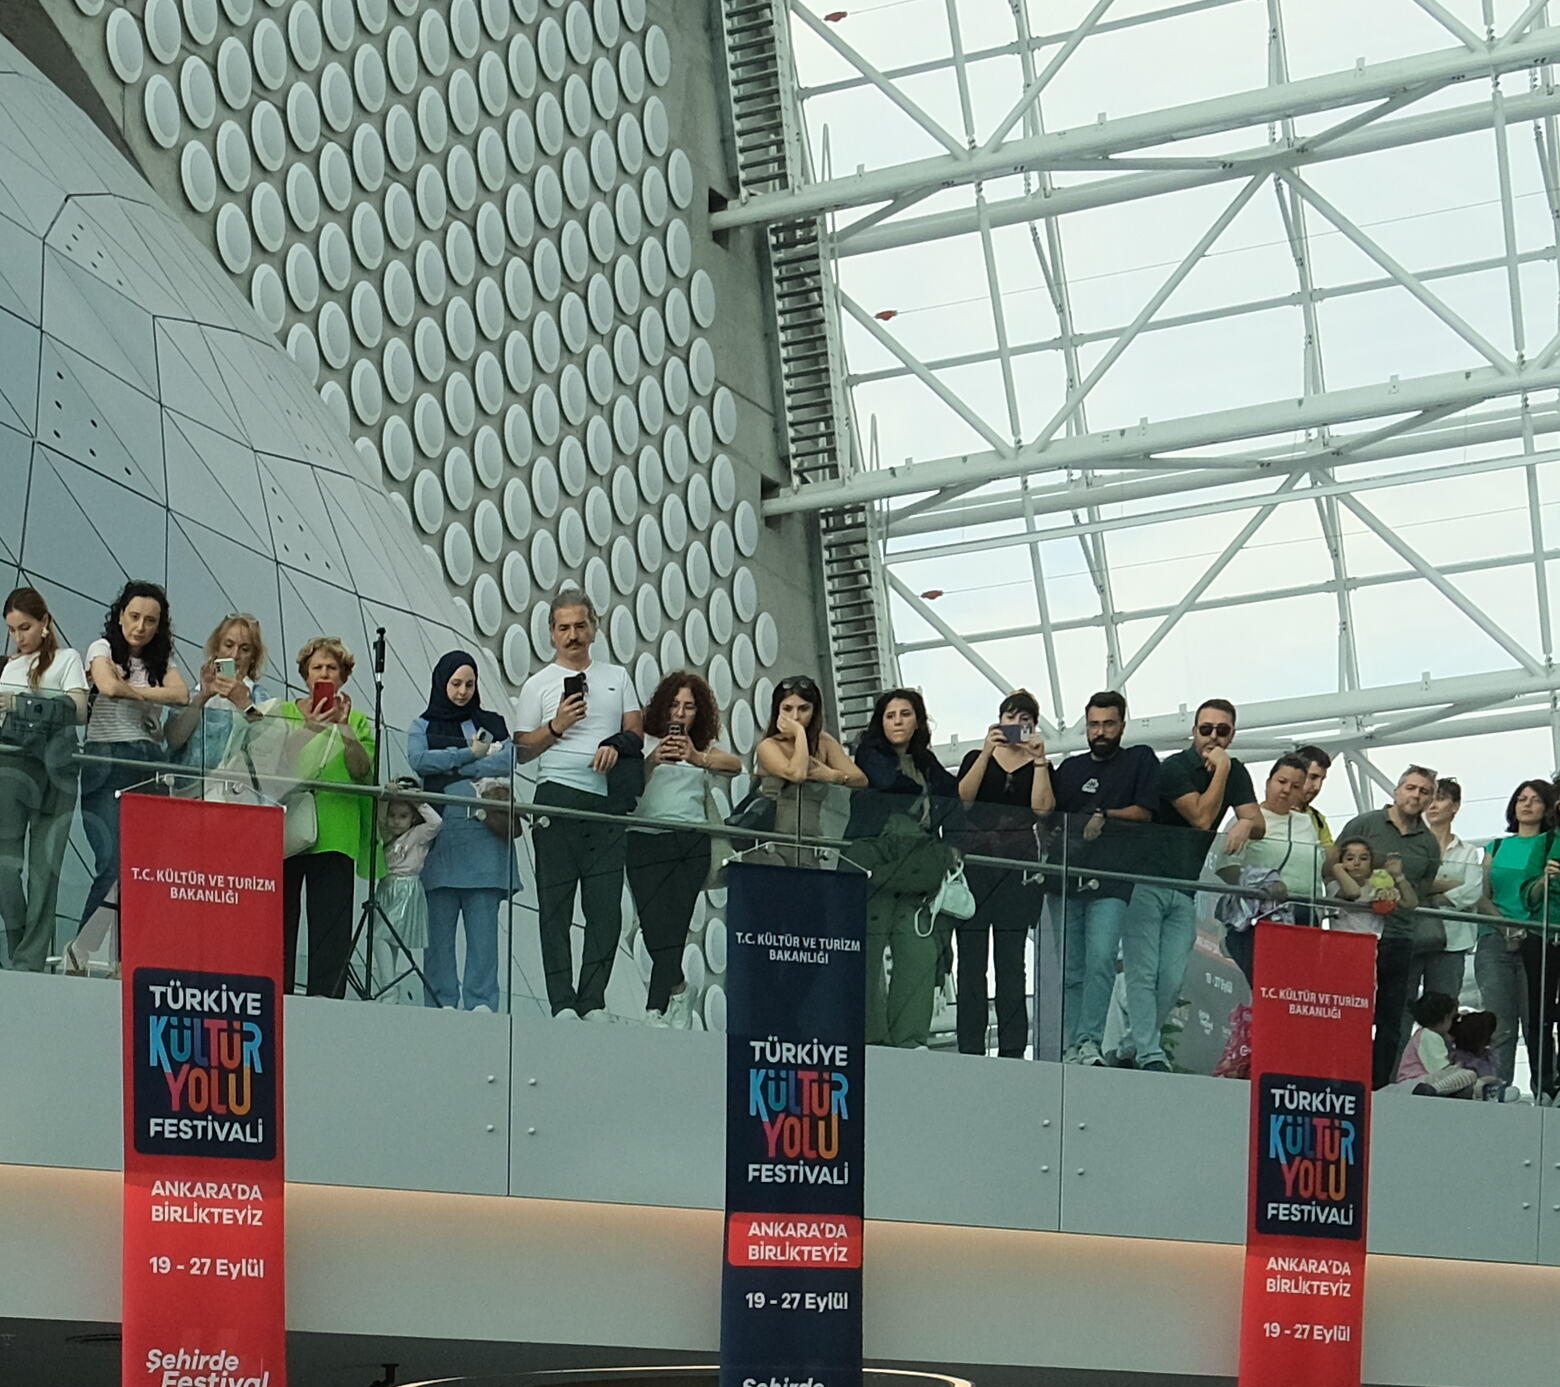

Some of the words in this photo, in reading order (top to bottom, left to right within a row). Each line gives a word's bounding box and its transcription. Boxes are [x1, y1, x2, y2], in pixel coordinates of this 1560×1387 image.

[131, 868, 154, 881] T.C.
[157, 868, 205, 886] KÜLTÜR
[209, 875, 224, 888] VE
[228, 877, 276, 892] TURİZM
[170, 887, 238, 905] BAKANLIĞI
[736, 932, 756, 945] T.C.
[758, 932, 800, 947] KÜLTÜR
[803, 937, 816, 949] VE
[819, 937, 861, 951] TURİZM
[769, 948, 829, 965] BAKANLIĞI
[149, 980, 261, 1016] TÜRKİYE
[1261, 987, 1278, 999] T.C.
[1280, 988, 1316, 1003] KÜLTÜR
[1319, 994, 1330, 1005] VE
[1333, 994, 1368, 1009] TURİZM
[1289, 1004, 1341, 1019] BAKANLIĞI
[149, 1016, 262, 1073] KÜLTÜR
[750, 1036, 848, 1067] TÜRKİYE
[164, 1064, 251, 1115] YOLU
[750, 1069, 849, 1122] KÜLTÜR
[1271, 1085, 1355, 1115] TÜRKİYE
[149, 1115, 263, 1143] FESTİVALİ
[762, 1112, 839, 1159] YOLU
[1269, 1115, 1355, 1165] KÜLTÜR
[748, 1160, 849, 1185] FESTİVALİ
[1280, 1156, 1346, 1201] YOLU
[151, 1180, 263, 1202] ANKARA'DA
[151, 1202, 263, 1226] BİRLİKTEYİZ
[1267, 1202, 1353, 1225] FESTİVALİ
[748, 1222, 848, 1239] ANKARA'DA
[748, 1241, 848, 1263] BİRLİKTEYİZ
[149, 1257, 171, 1274] 19
[190, 1258, 211, 1276] 27
[216, 1259, 264, 1280] Eylül
[1266, 1276, 1351, 1297] BİRLİKTEYİZ
[746, 1292, 765, 1308] 19
[781, 1293, 800, 1309] 27
[805, 1293, 848, 1313] Eylül
[1263, 1323, 1280, 1338] 19
[1294, 1324, 1309, 1339] 27
[1313, 1324, 1350, 1343] Eylül
[146, 1348, 239, 1373] Şehirde
